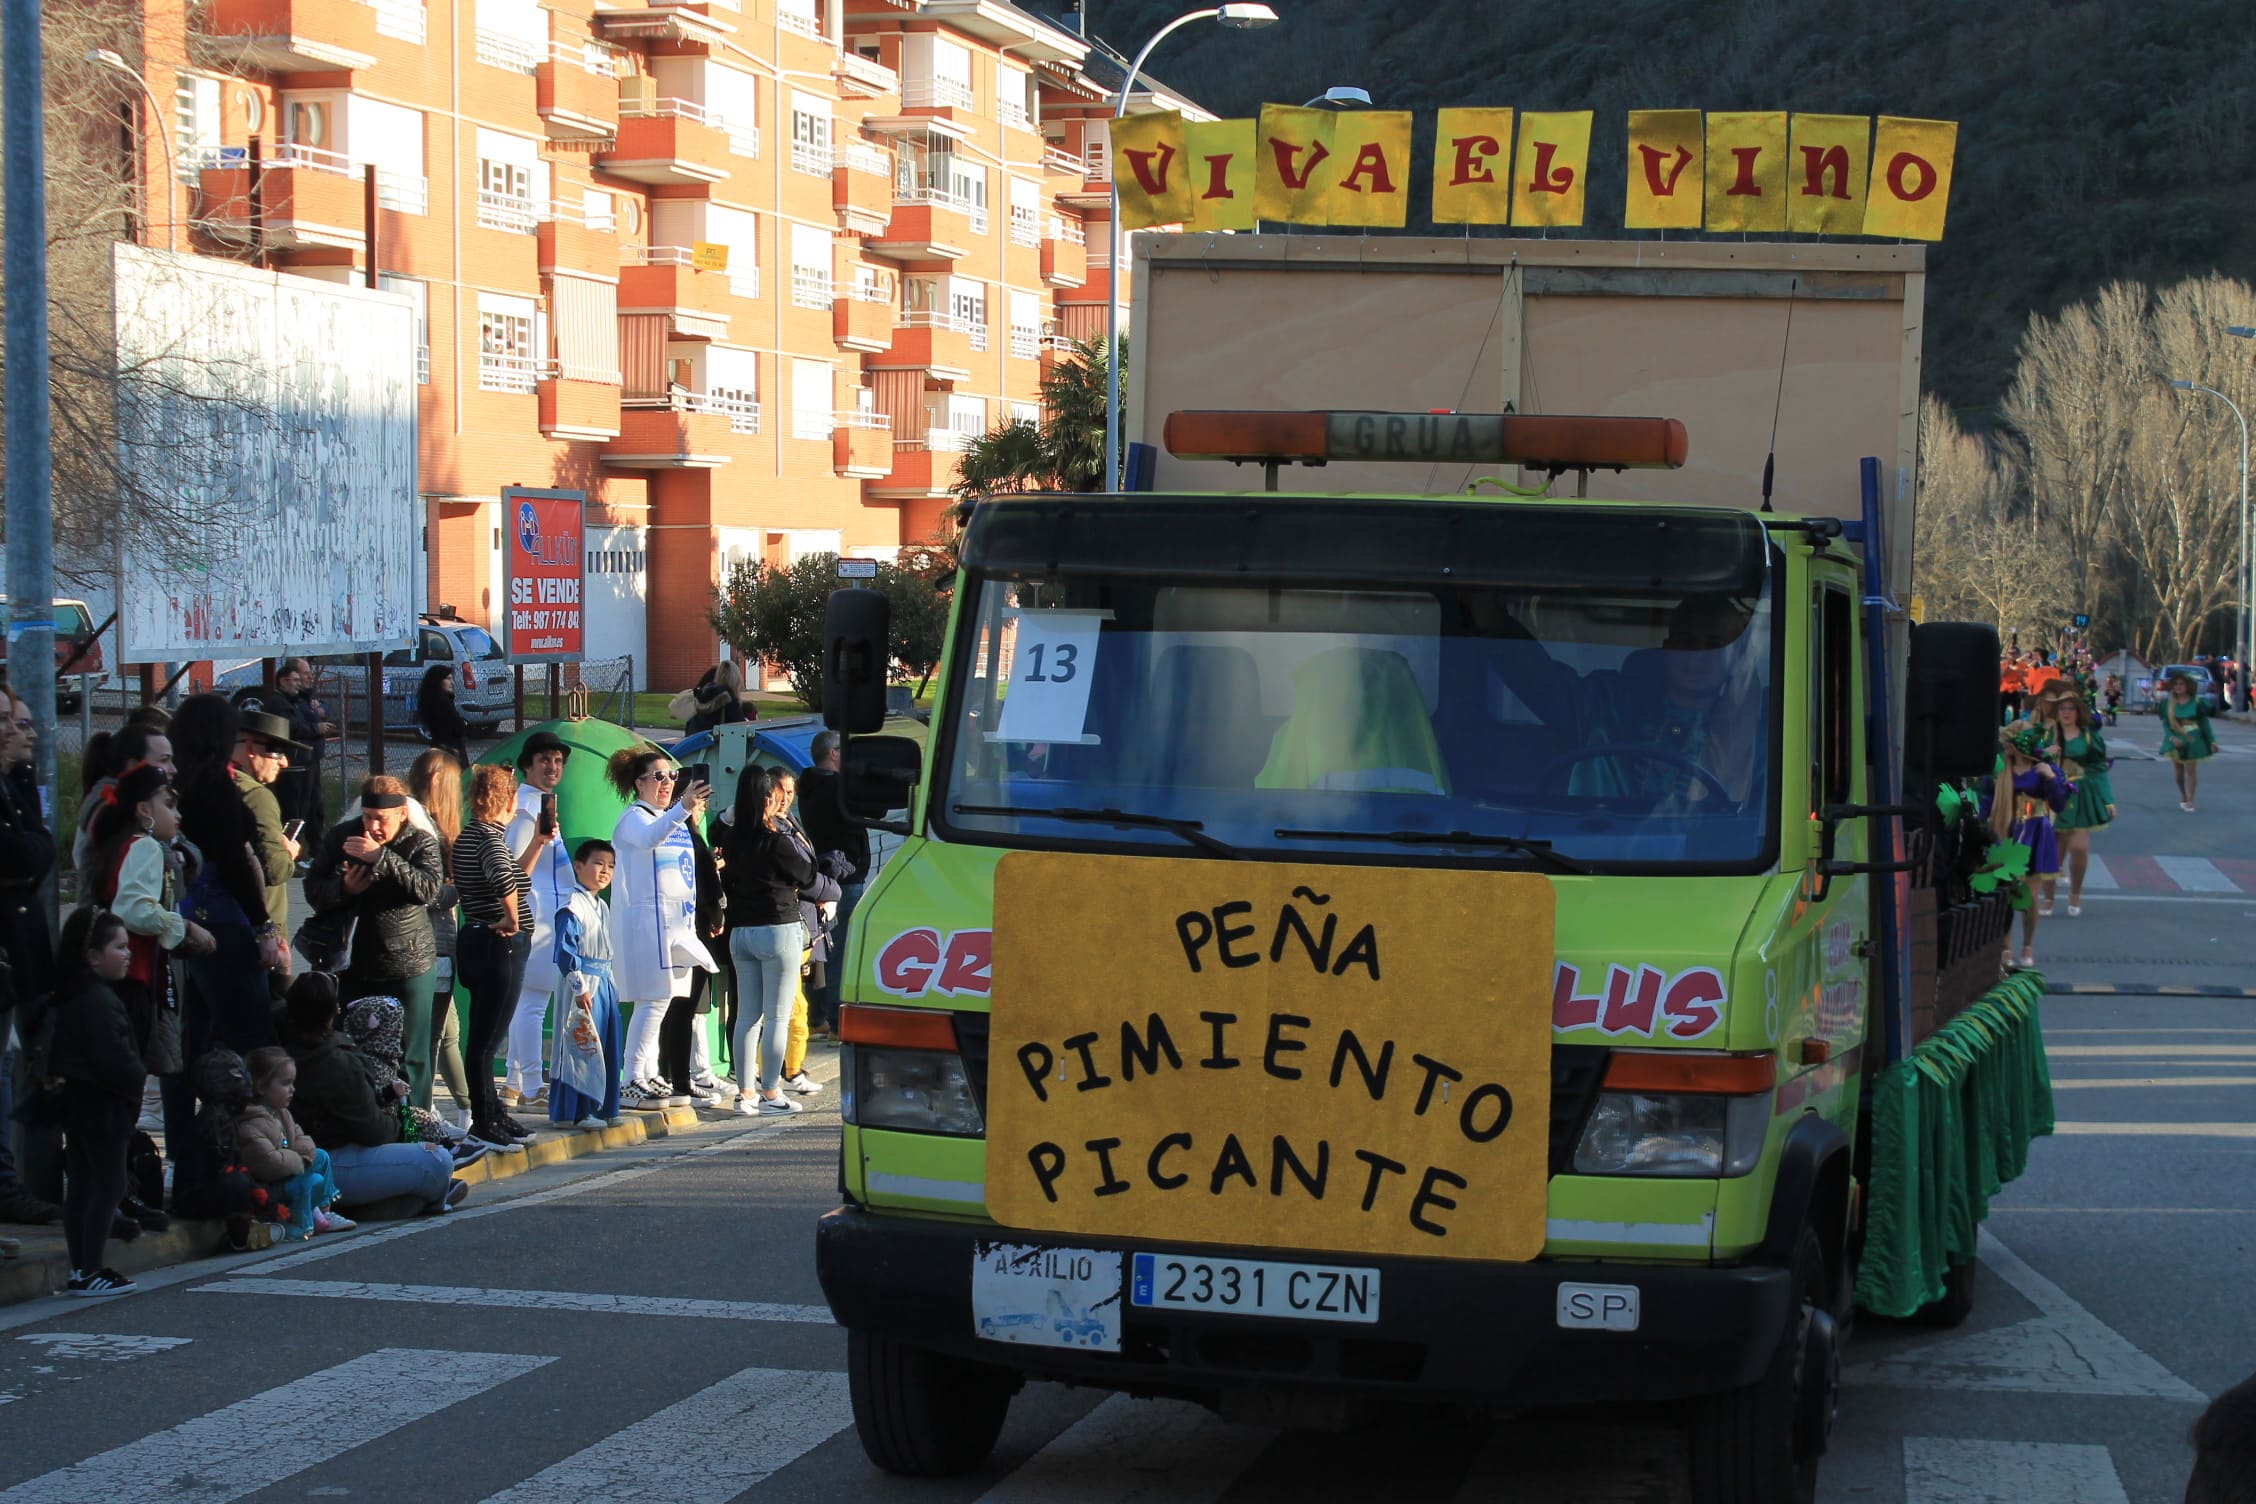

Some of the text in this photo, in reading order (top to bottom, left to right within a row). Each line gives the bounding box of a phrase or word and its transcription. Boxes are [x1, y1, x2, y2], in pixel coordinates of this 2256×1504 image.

[1122, 134, 1938, 203] VIVA EL VINO
[1354, 415, 1474, 455] GRUA
[511, 577, 580, 605] SE VENDE
[511, 610, 532, 630] Telf:
[533, 611, 549, 630] 987
[551, 610, 566, 629] 174
[1024, 643, 1078, 683] 13
[1174, 885, 1382, 983] PEÑA
[1016, 1011, 1513, 1144] PIMIENTO
[1026, 1132, 1469, 1238] PICANTE
[1164, 1262, 1265, 1308] 2331
[1288, 1271, 1369, 1314] CZN
[1570, 1293, 1627, 1321] SP
